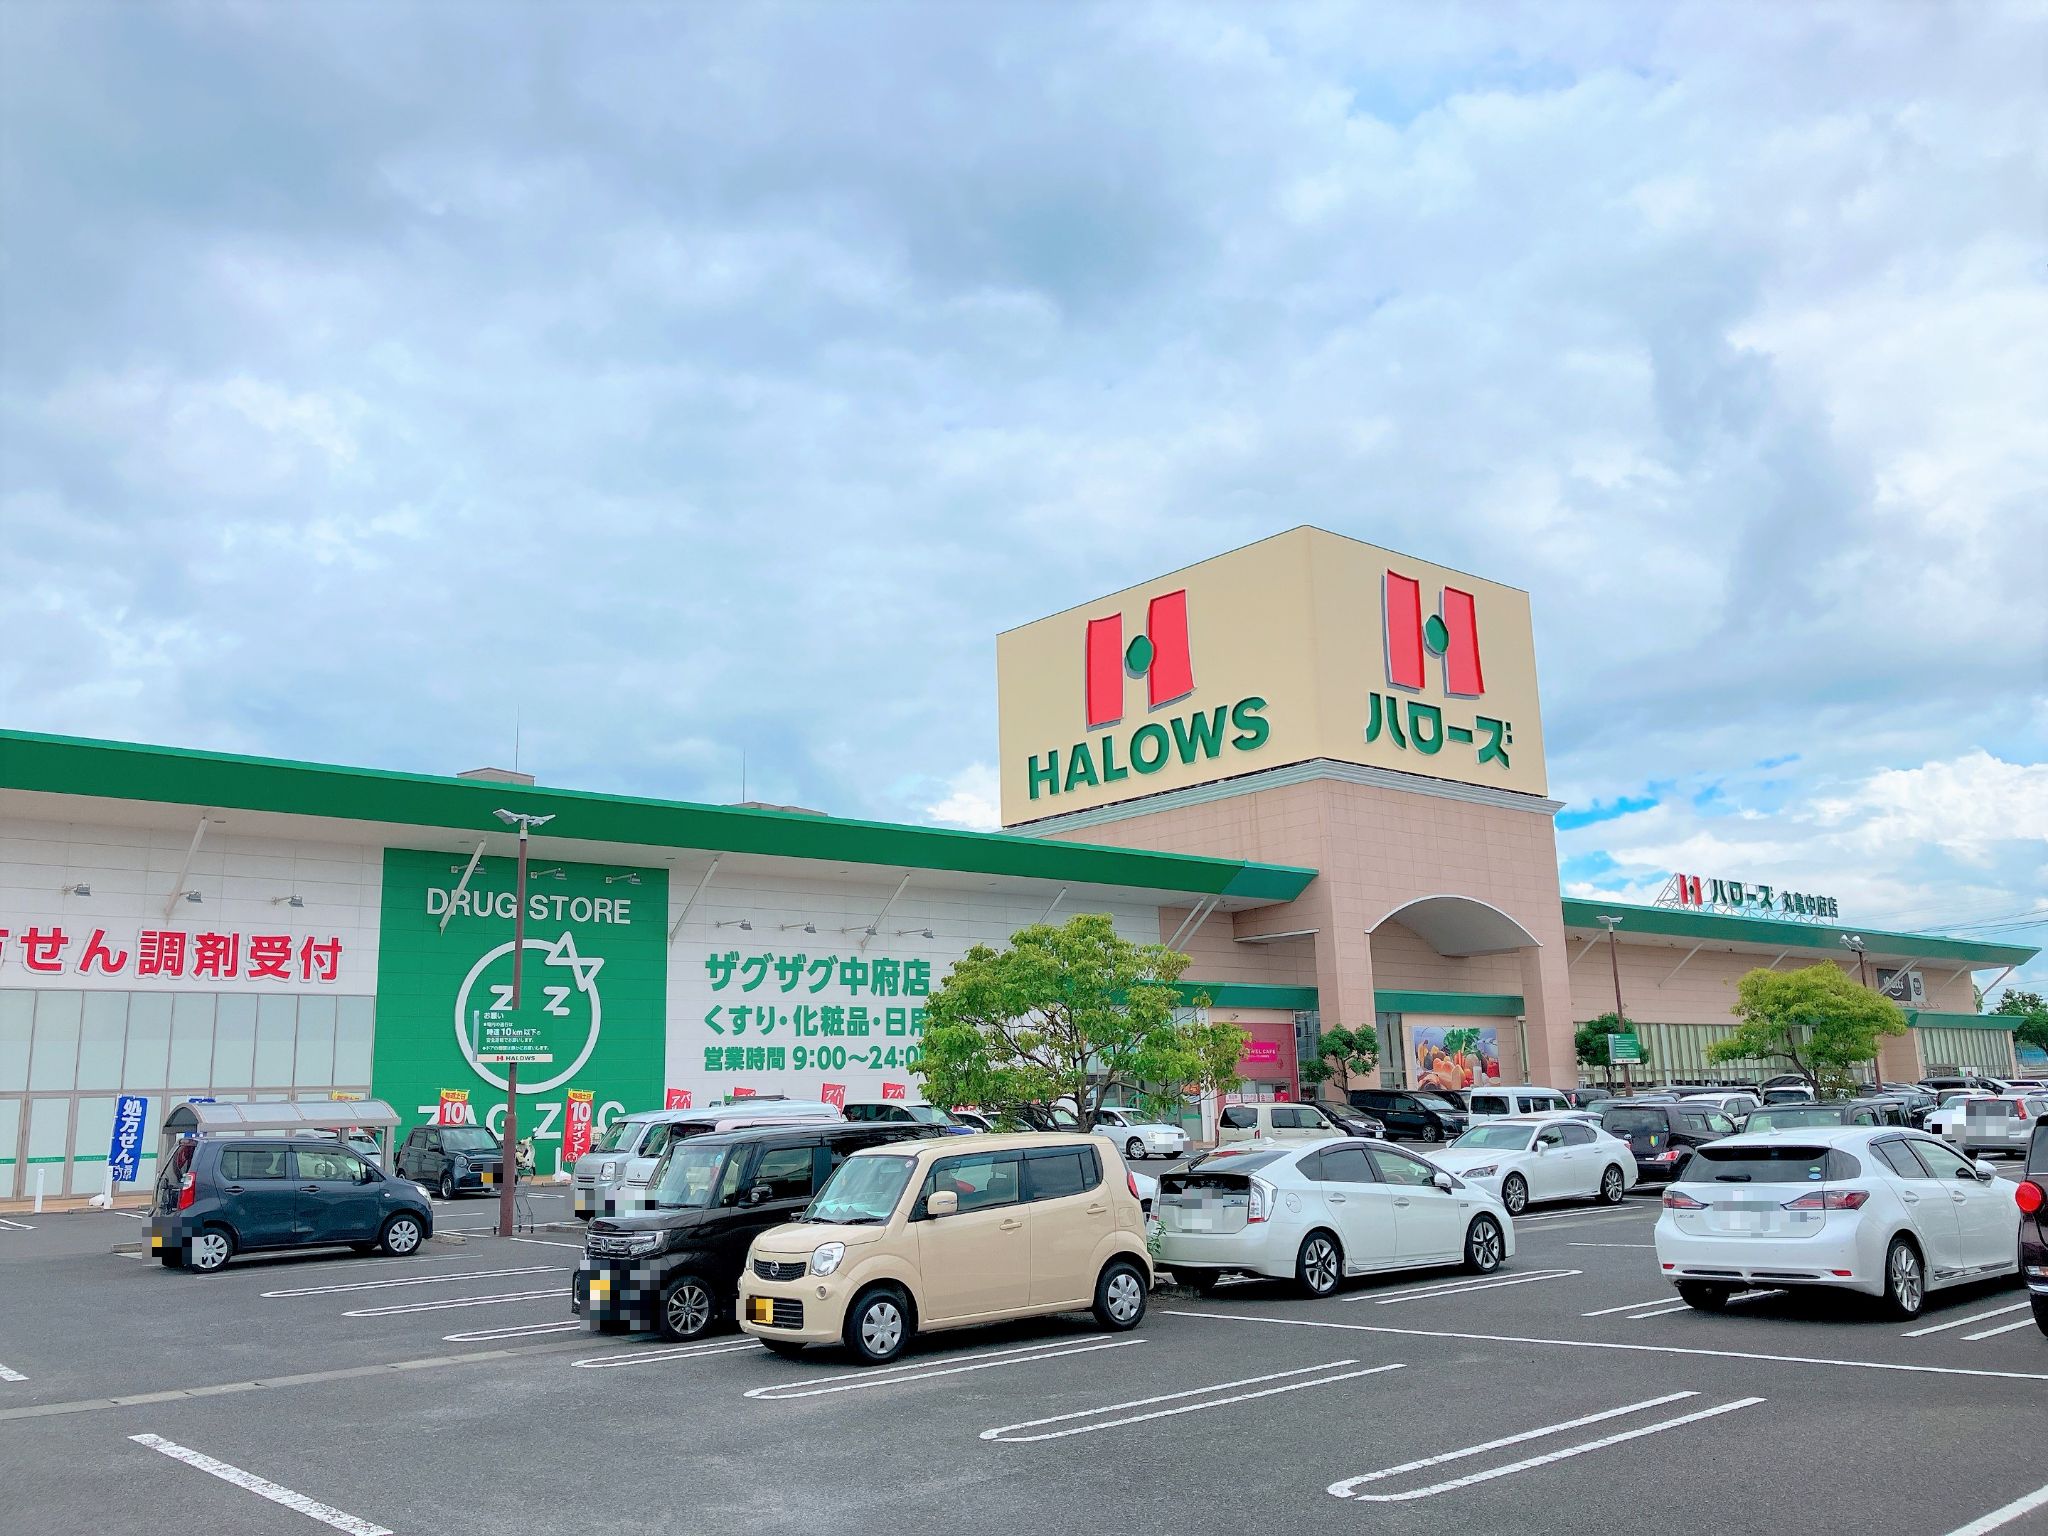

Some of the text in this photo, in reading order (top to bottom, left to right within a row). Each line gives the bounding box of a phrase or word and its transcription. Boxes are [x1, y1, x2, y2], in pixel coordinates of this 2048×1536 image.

[1028, 697, 1270, 800] HALOWS
[1365, 692, 1513, 769] ハローズ
[427, 888, 631, 925] DRUG STORE
[1711, 879, 1773, 910] ハローズ
[0, 927, 343, 980] せん調剤受付
[705, 951, 931, 997] ザグザグ中府店
[483, 1012, 504, 1020] お願い
[704, 1046, 786, 1071] 営業時間
[444, 1102, 465, 1123] 10
[535, 1101, 626, 1140] ZG
[570, 1101, 591, 1122] 10
[116, 1099, 142, 1164] 処方せん
